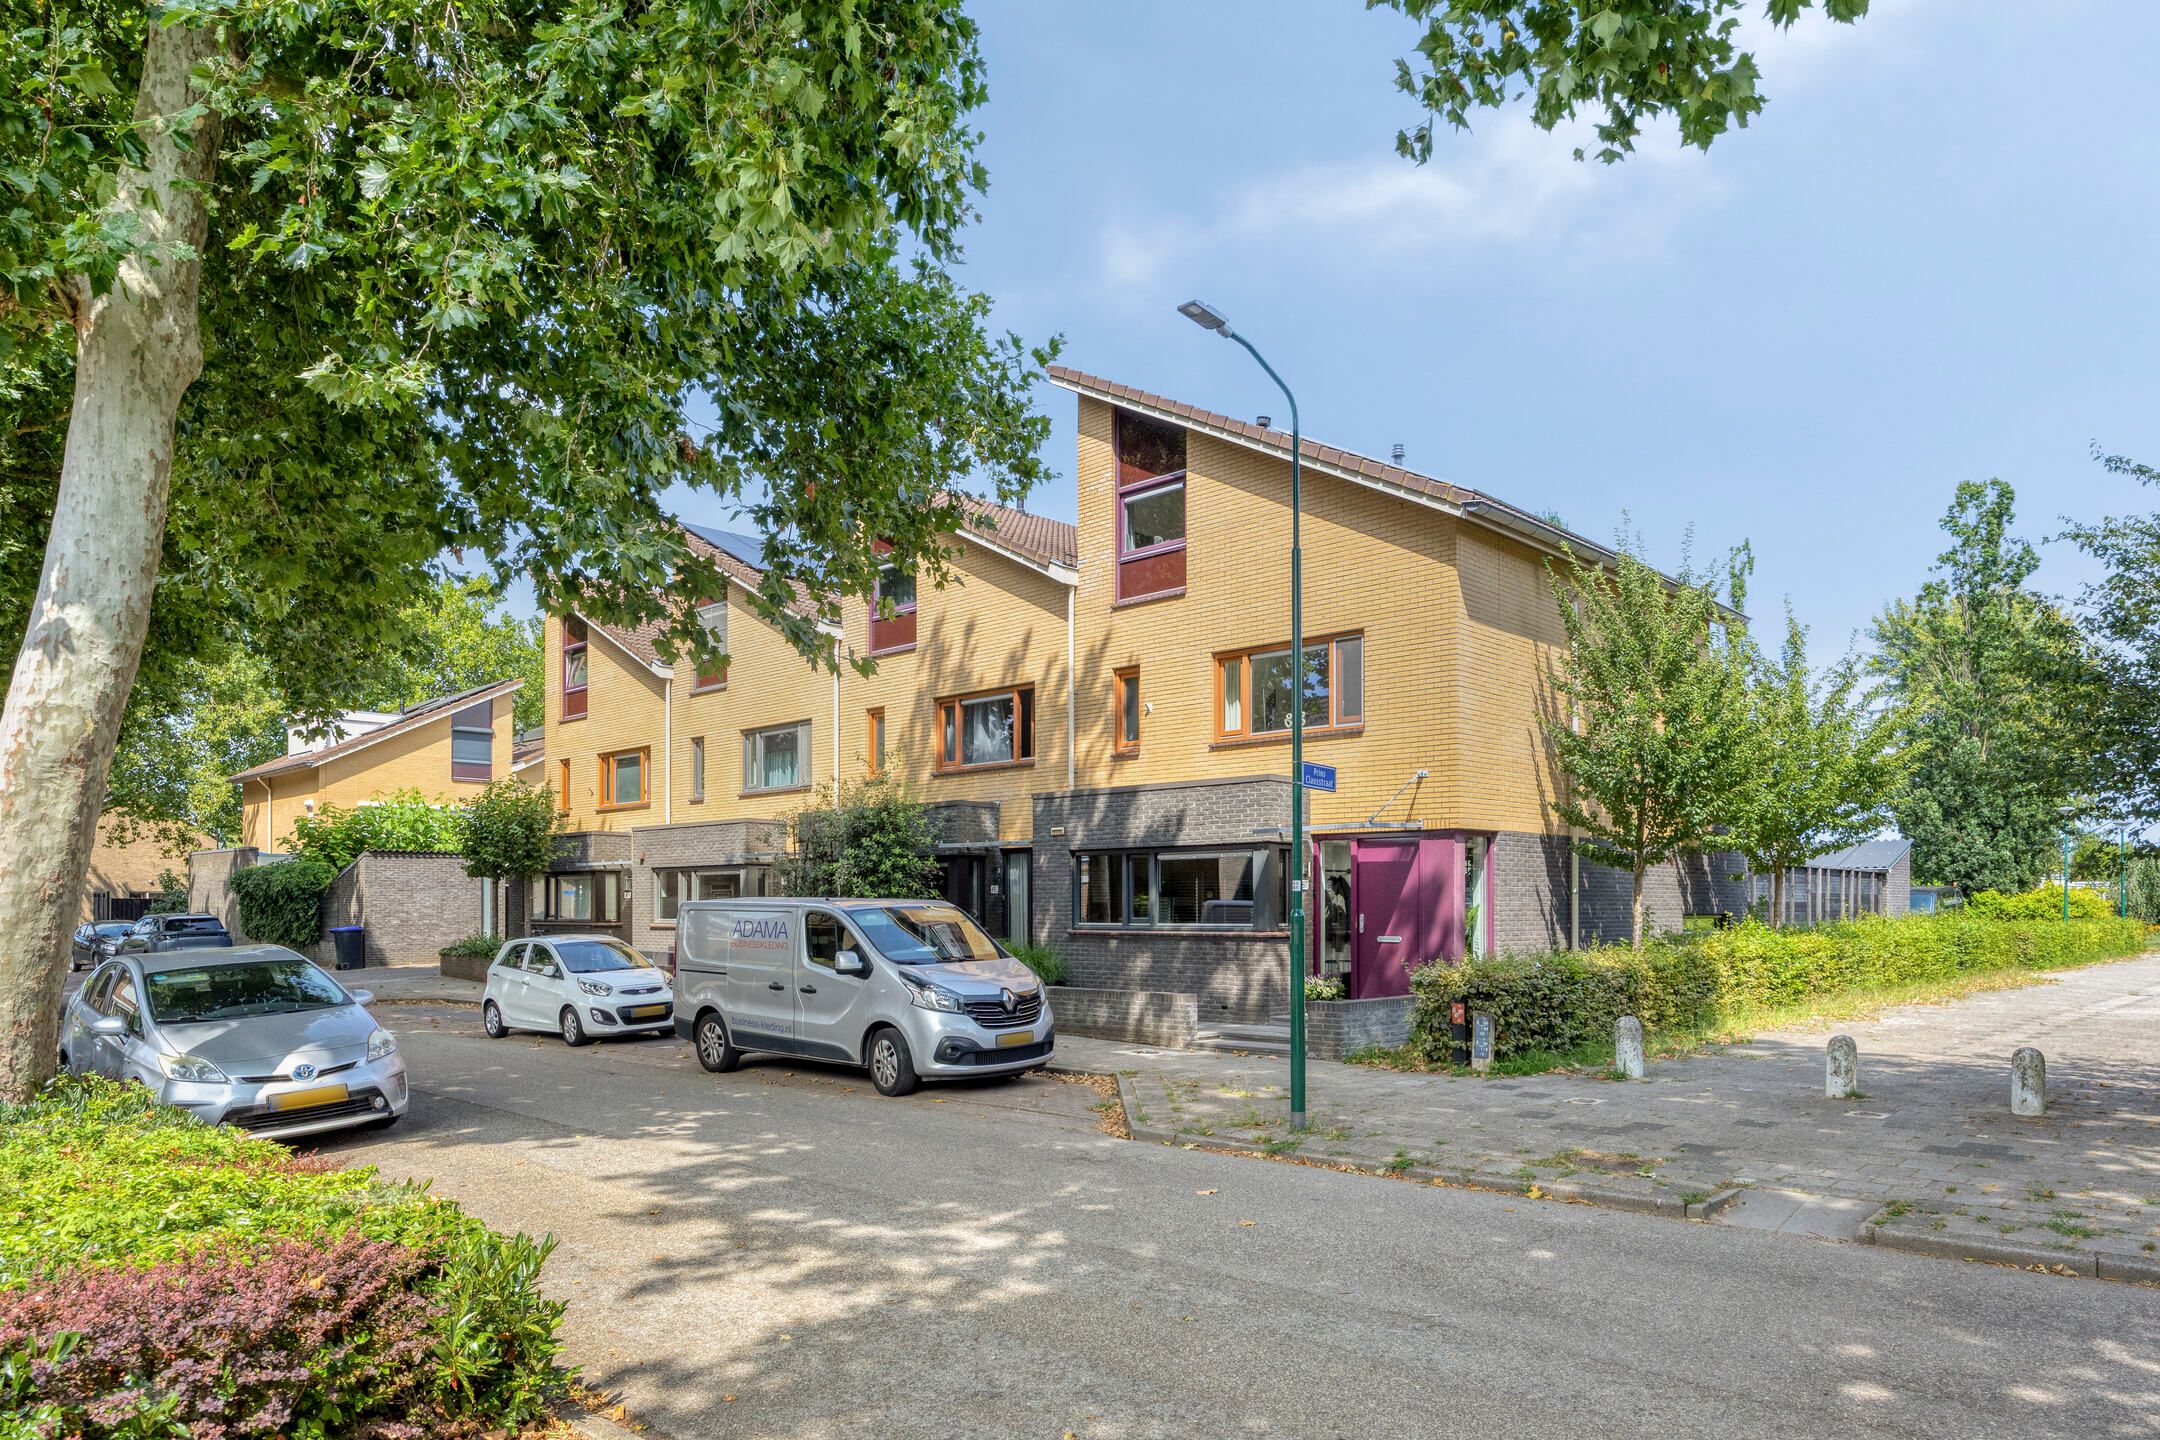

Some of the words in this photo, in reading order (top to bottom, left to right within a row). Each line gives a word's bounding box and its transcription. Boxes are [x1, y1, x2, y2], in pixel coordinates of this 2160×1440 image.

[1313, 768, 1326, 777] Prins
[1305, 775, 1334, 788] Clausstraat
[732, 920, 788, 939] ADAMA
[730, 939, 789, 950] BUSINESSKLEDING
[731, 1016, 792, 1034] business-kleding.nl
